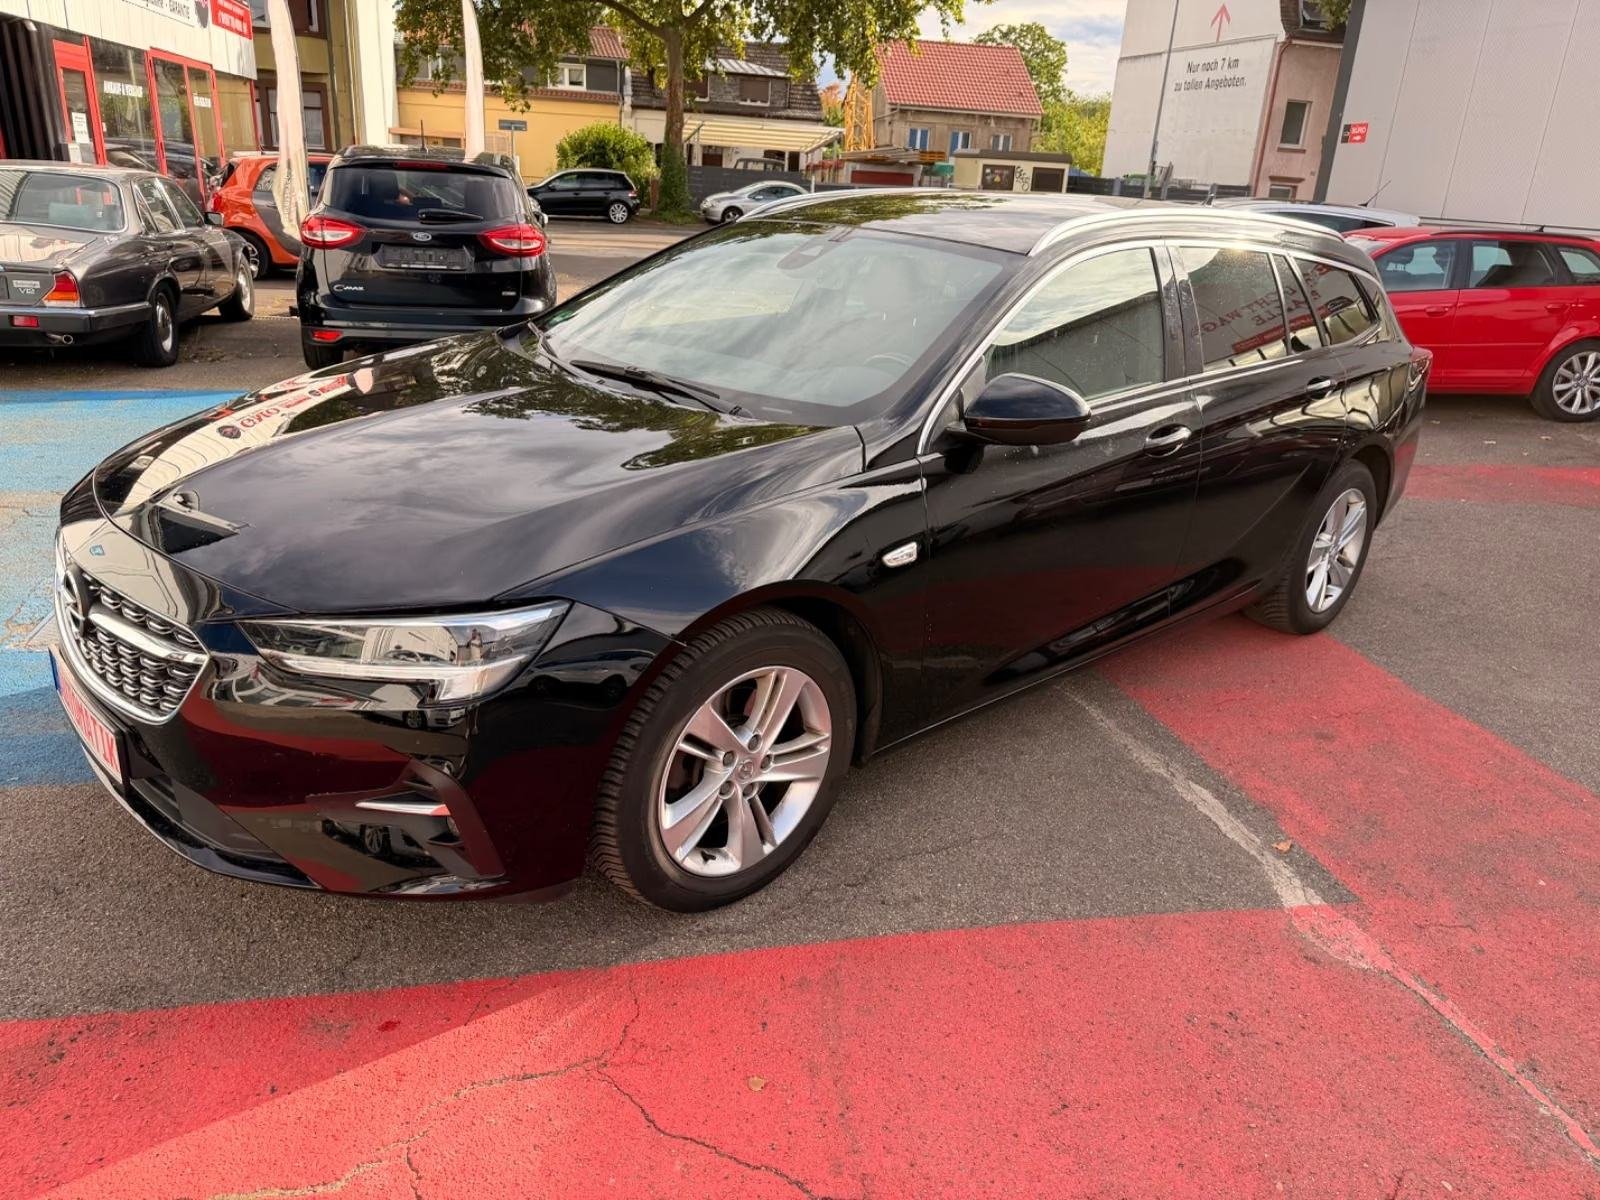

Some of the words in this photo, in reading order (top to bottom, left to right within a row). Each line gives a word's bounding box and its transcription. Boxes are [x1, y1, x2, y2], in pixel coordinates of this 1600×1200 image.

[1186, 61, 1200, 74] Nur
[1201, 59, 1219, 73] noch
[1221, 57, 1226, 70] 7
[1227, 57, 1240, 70] km
[1174, 81, 1182, 92] zu
[1183, 79, 1203, 92] tollen
